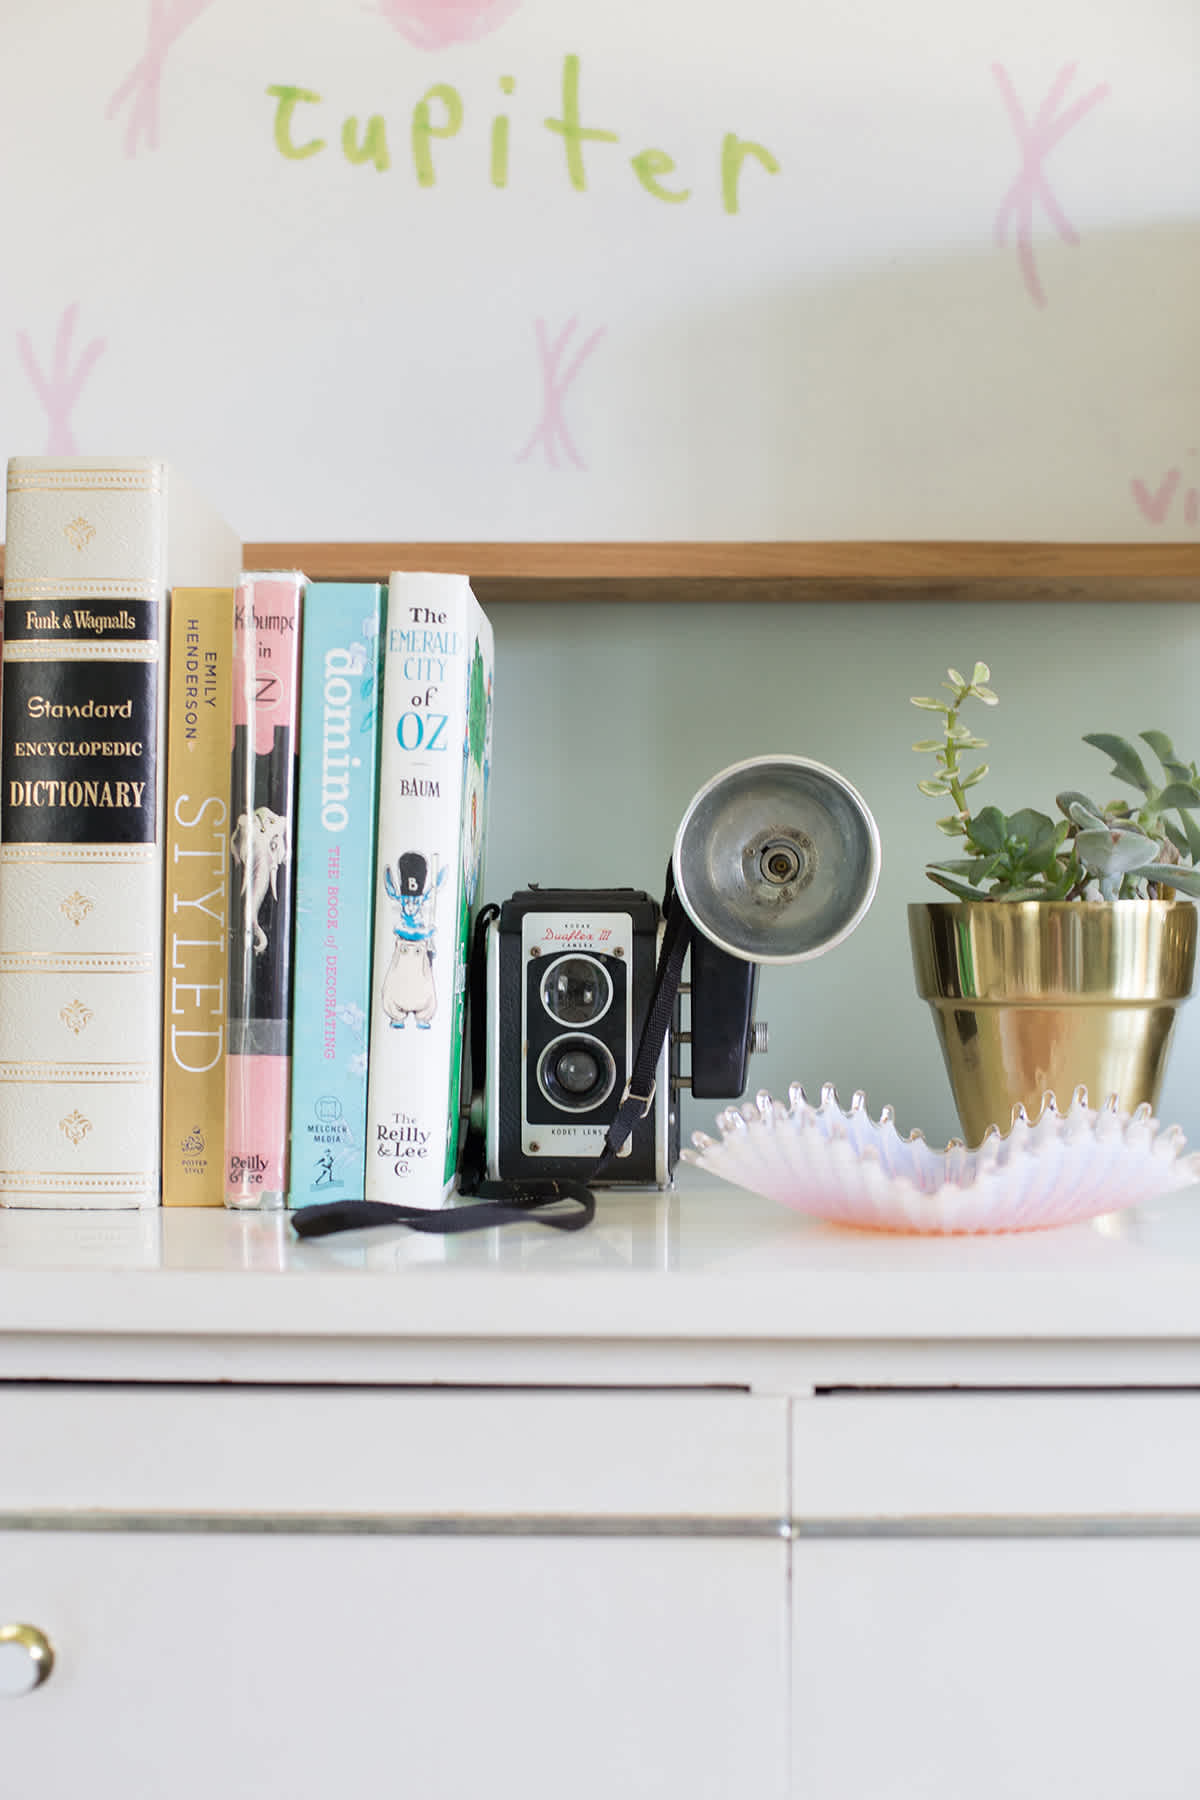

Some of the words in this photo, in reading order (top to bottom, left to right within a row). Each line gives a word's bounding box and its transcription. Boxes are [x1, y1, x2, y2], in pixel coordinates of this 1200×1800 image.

[26, 610, 60, 630] Funk
[62, 614, 72, 630] &
[73, 610, 136, 633] Wagnalls
[410, 607, 447, 624] The
[258, 641, 272, 658] in
[389, 629, 464, 655] EMERALD
[185, 619, 199, 739] HENDERSON
[204, 652, 217, 708] EMILY
[404, 657, 447, 682] CITY
[27, 695, 133, 719] Standard
[411, 686, 438, 707] of
[321, 642, 367, 832] domino
[396, 711, 449, 752] OZ
[14, 742, 143, 757] ENCYCLOPEDIC
[9, 780, 146, 808] DICTIONARY
[400, 777, 440, 798] BAUM
[327, 845, 341, 879] THE
[408, 877, 418, 891] B
[327, 886, 339, 929] BOOK
[171, 795, 227, 1073] STYLED
[323, 935, 338, 950] of
[323, 955, 337, 1060] DECORATING
[392, 1112, 416, 1124] The
[377, 1124, 431, 1145] Reilly
[377, 1143, 391, 1157] &
[394, 1142, 429, 1158] Lee
[231, 1154, 269, 1172] Reilly
